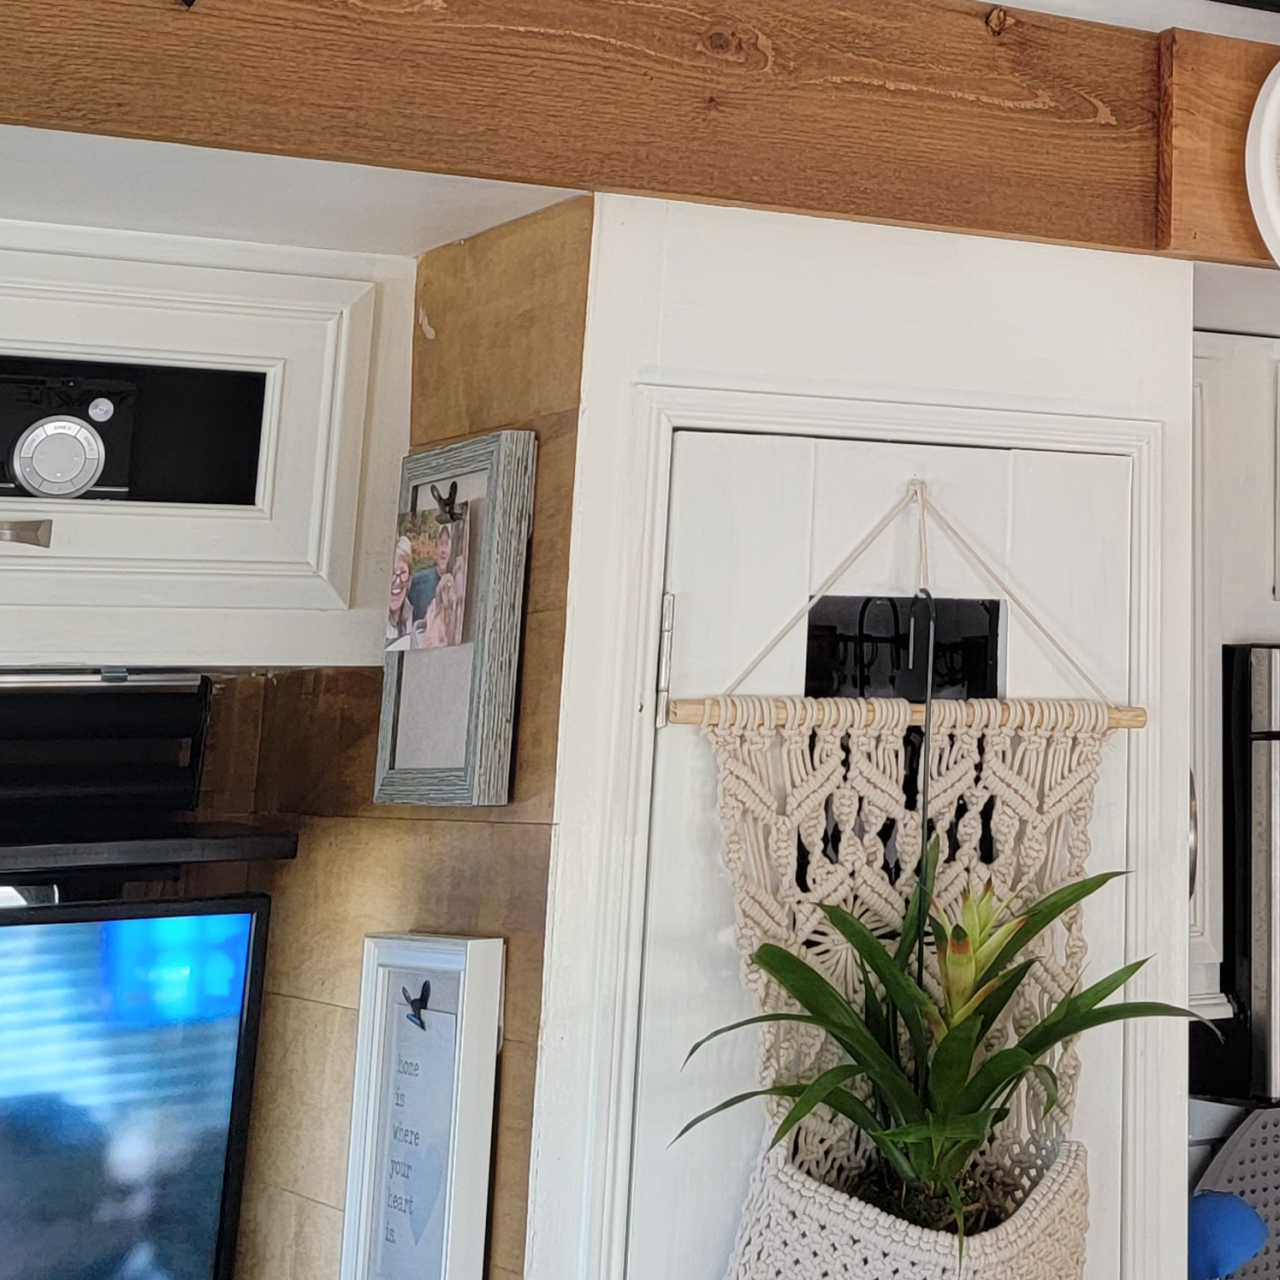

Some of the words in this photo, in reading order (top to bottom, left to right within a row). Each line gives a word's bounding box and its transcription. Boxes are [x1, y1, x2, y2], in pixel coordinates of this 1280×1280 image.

[397, 1053, 420, 1077] home
[395, 1086, 406, 1108] is
[392, 1120, 420, 1147] where
[389, 1158, 412, 1180] your
[386, 1185, 414, 1215] heart
